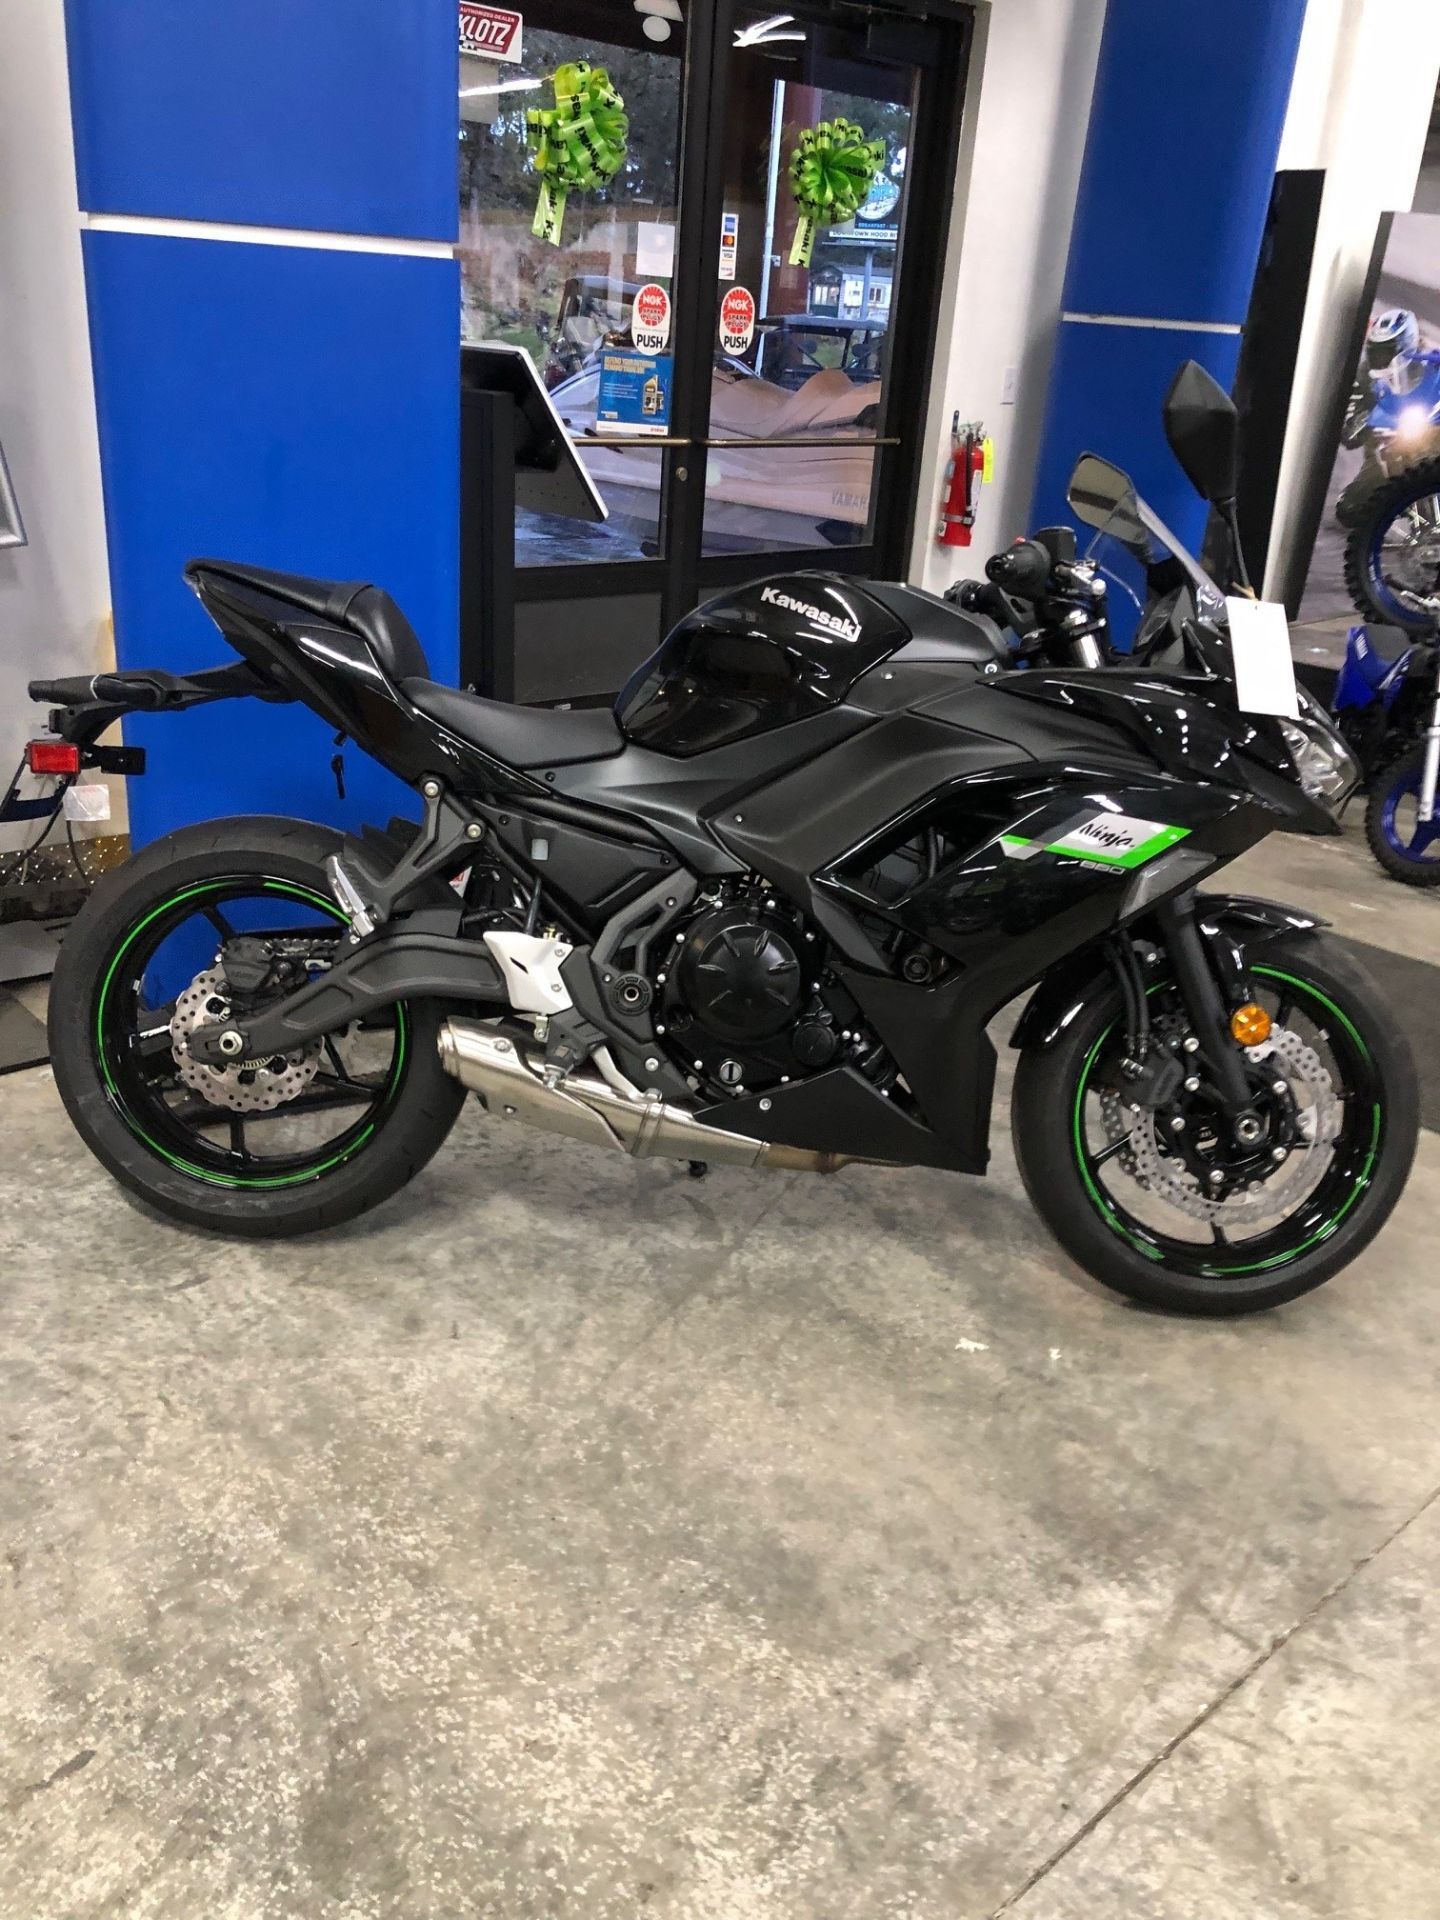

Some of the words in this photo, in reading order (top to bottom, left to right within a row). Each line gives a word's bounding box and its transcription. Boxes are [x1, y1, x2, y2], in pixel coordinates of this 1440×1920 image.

[494, 14, 515, 23] DEALER
[459, 14, 512, 46] KLOTZ
[642, 294, 663, 306] NGK
[728, 299, 748, 311] NGK
[636, 333, 663, 349] PUSH
[723, 335, 748, 349] PUSH
[1079, 823, 1135, 848] Ninja
